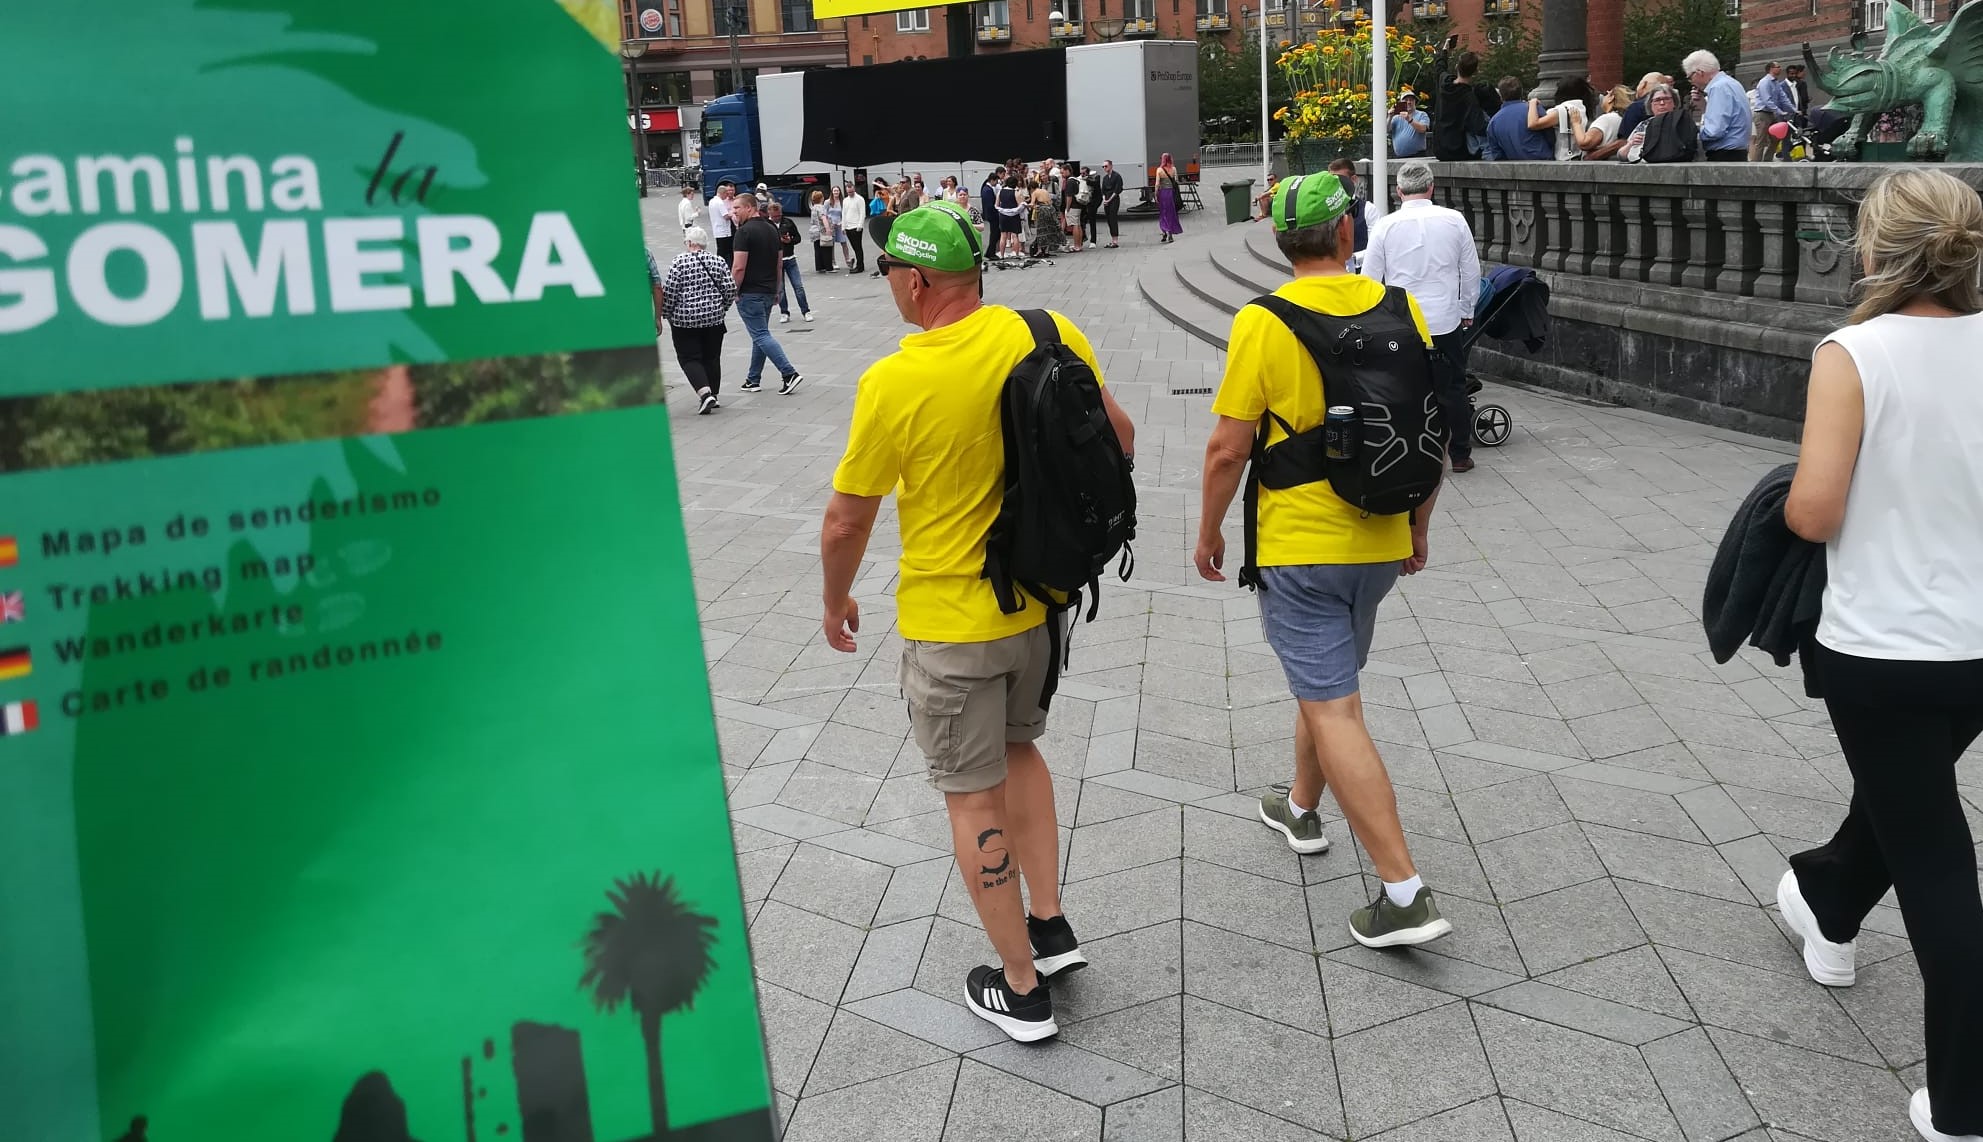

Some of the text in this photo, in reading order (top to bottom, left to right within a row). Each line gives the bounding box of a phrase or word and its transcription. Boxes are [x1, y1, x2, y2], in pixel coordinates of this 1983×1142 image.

[1247, 14, 1285, 28] PAACE
[627, 113, 652, 130] NG
[0, 130, 439, 217] amina la
[0, 210, 606, 334] GOMERA
[40, 485, 443, 559] Mapa de senderismo
[47, 552, 317, 612] Trekking map
[54, 600, 305, 665] Wanderkarte
[61, 629, 444, 719] Carte de randonnée
[996, 875, 1008, 886] the
